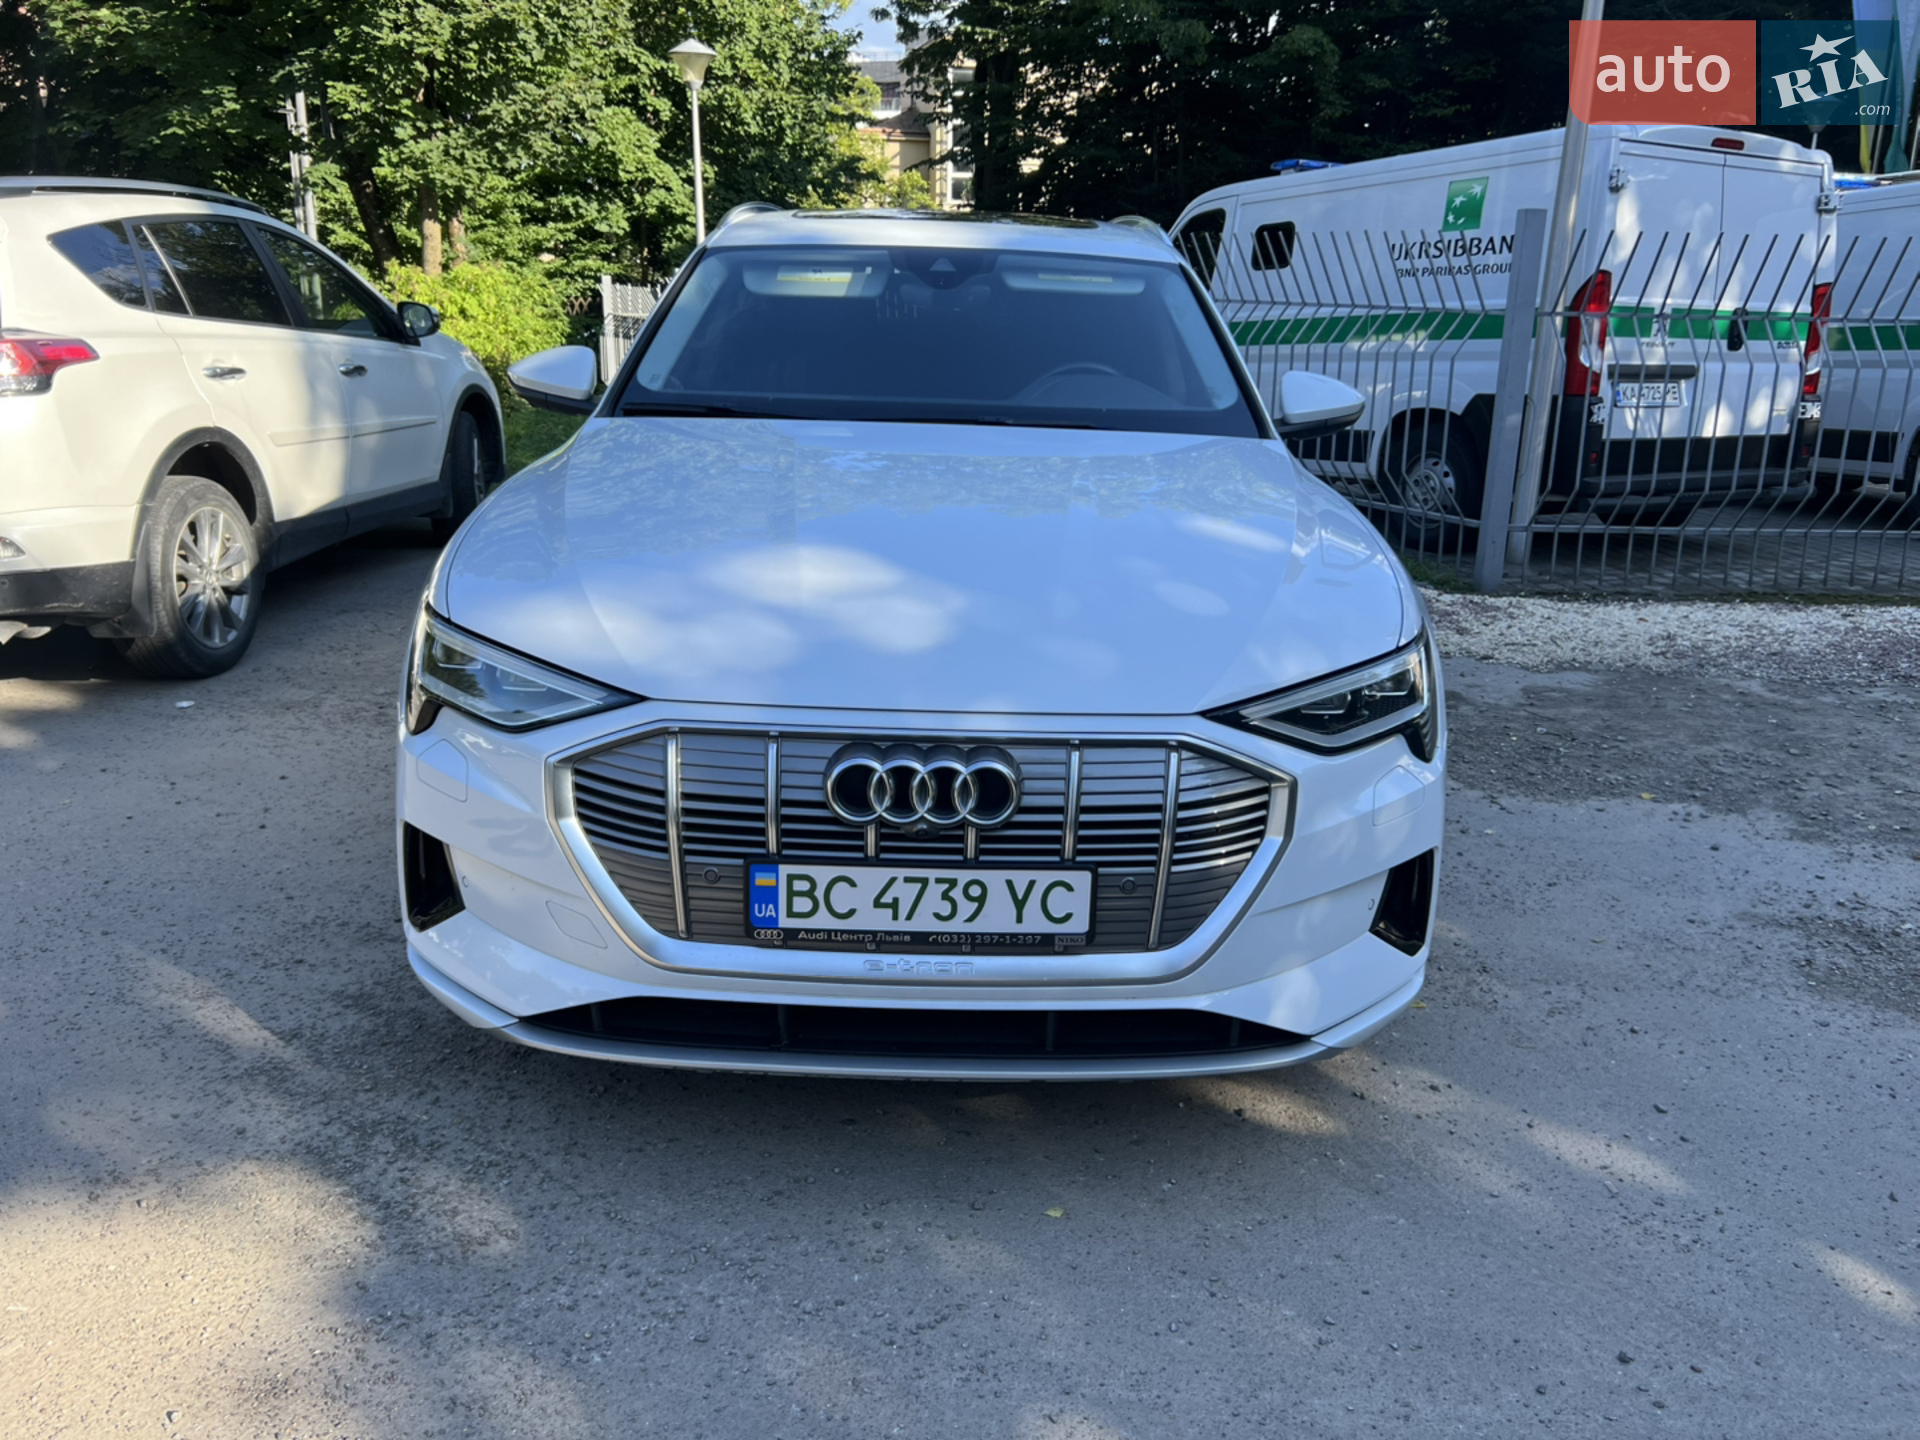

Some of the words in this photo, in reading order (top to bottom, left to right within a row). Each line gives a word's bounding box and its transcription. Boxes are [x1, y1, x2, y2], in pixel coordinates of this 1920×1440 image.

[785, 873, 858, 920] BC
[872, 876, 989, 923] 4739
[1005, 879, 1076, 925] YC
[754, 903, 777, 918] UA
[798, 930, 828, 940] Audi
[831, 930, 873, 942] Центр
[876, 932, 911, 942] Львів
[938, 934, 971, 944] (032)
[975, 935, 1042, 944] 297-1-297
[1057, 936, 1085, 945] NIKO
